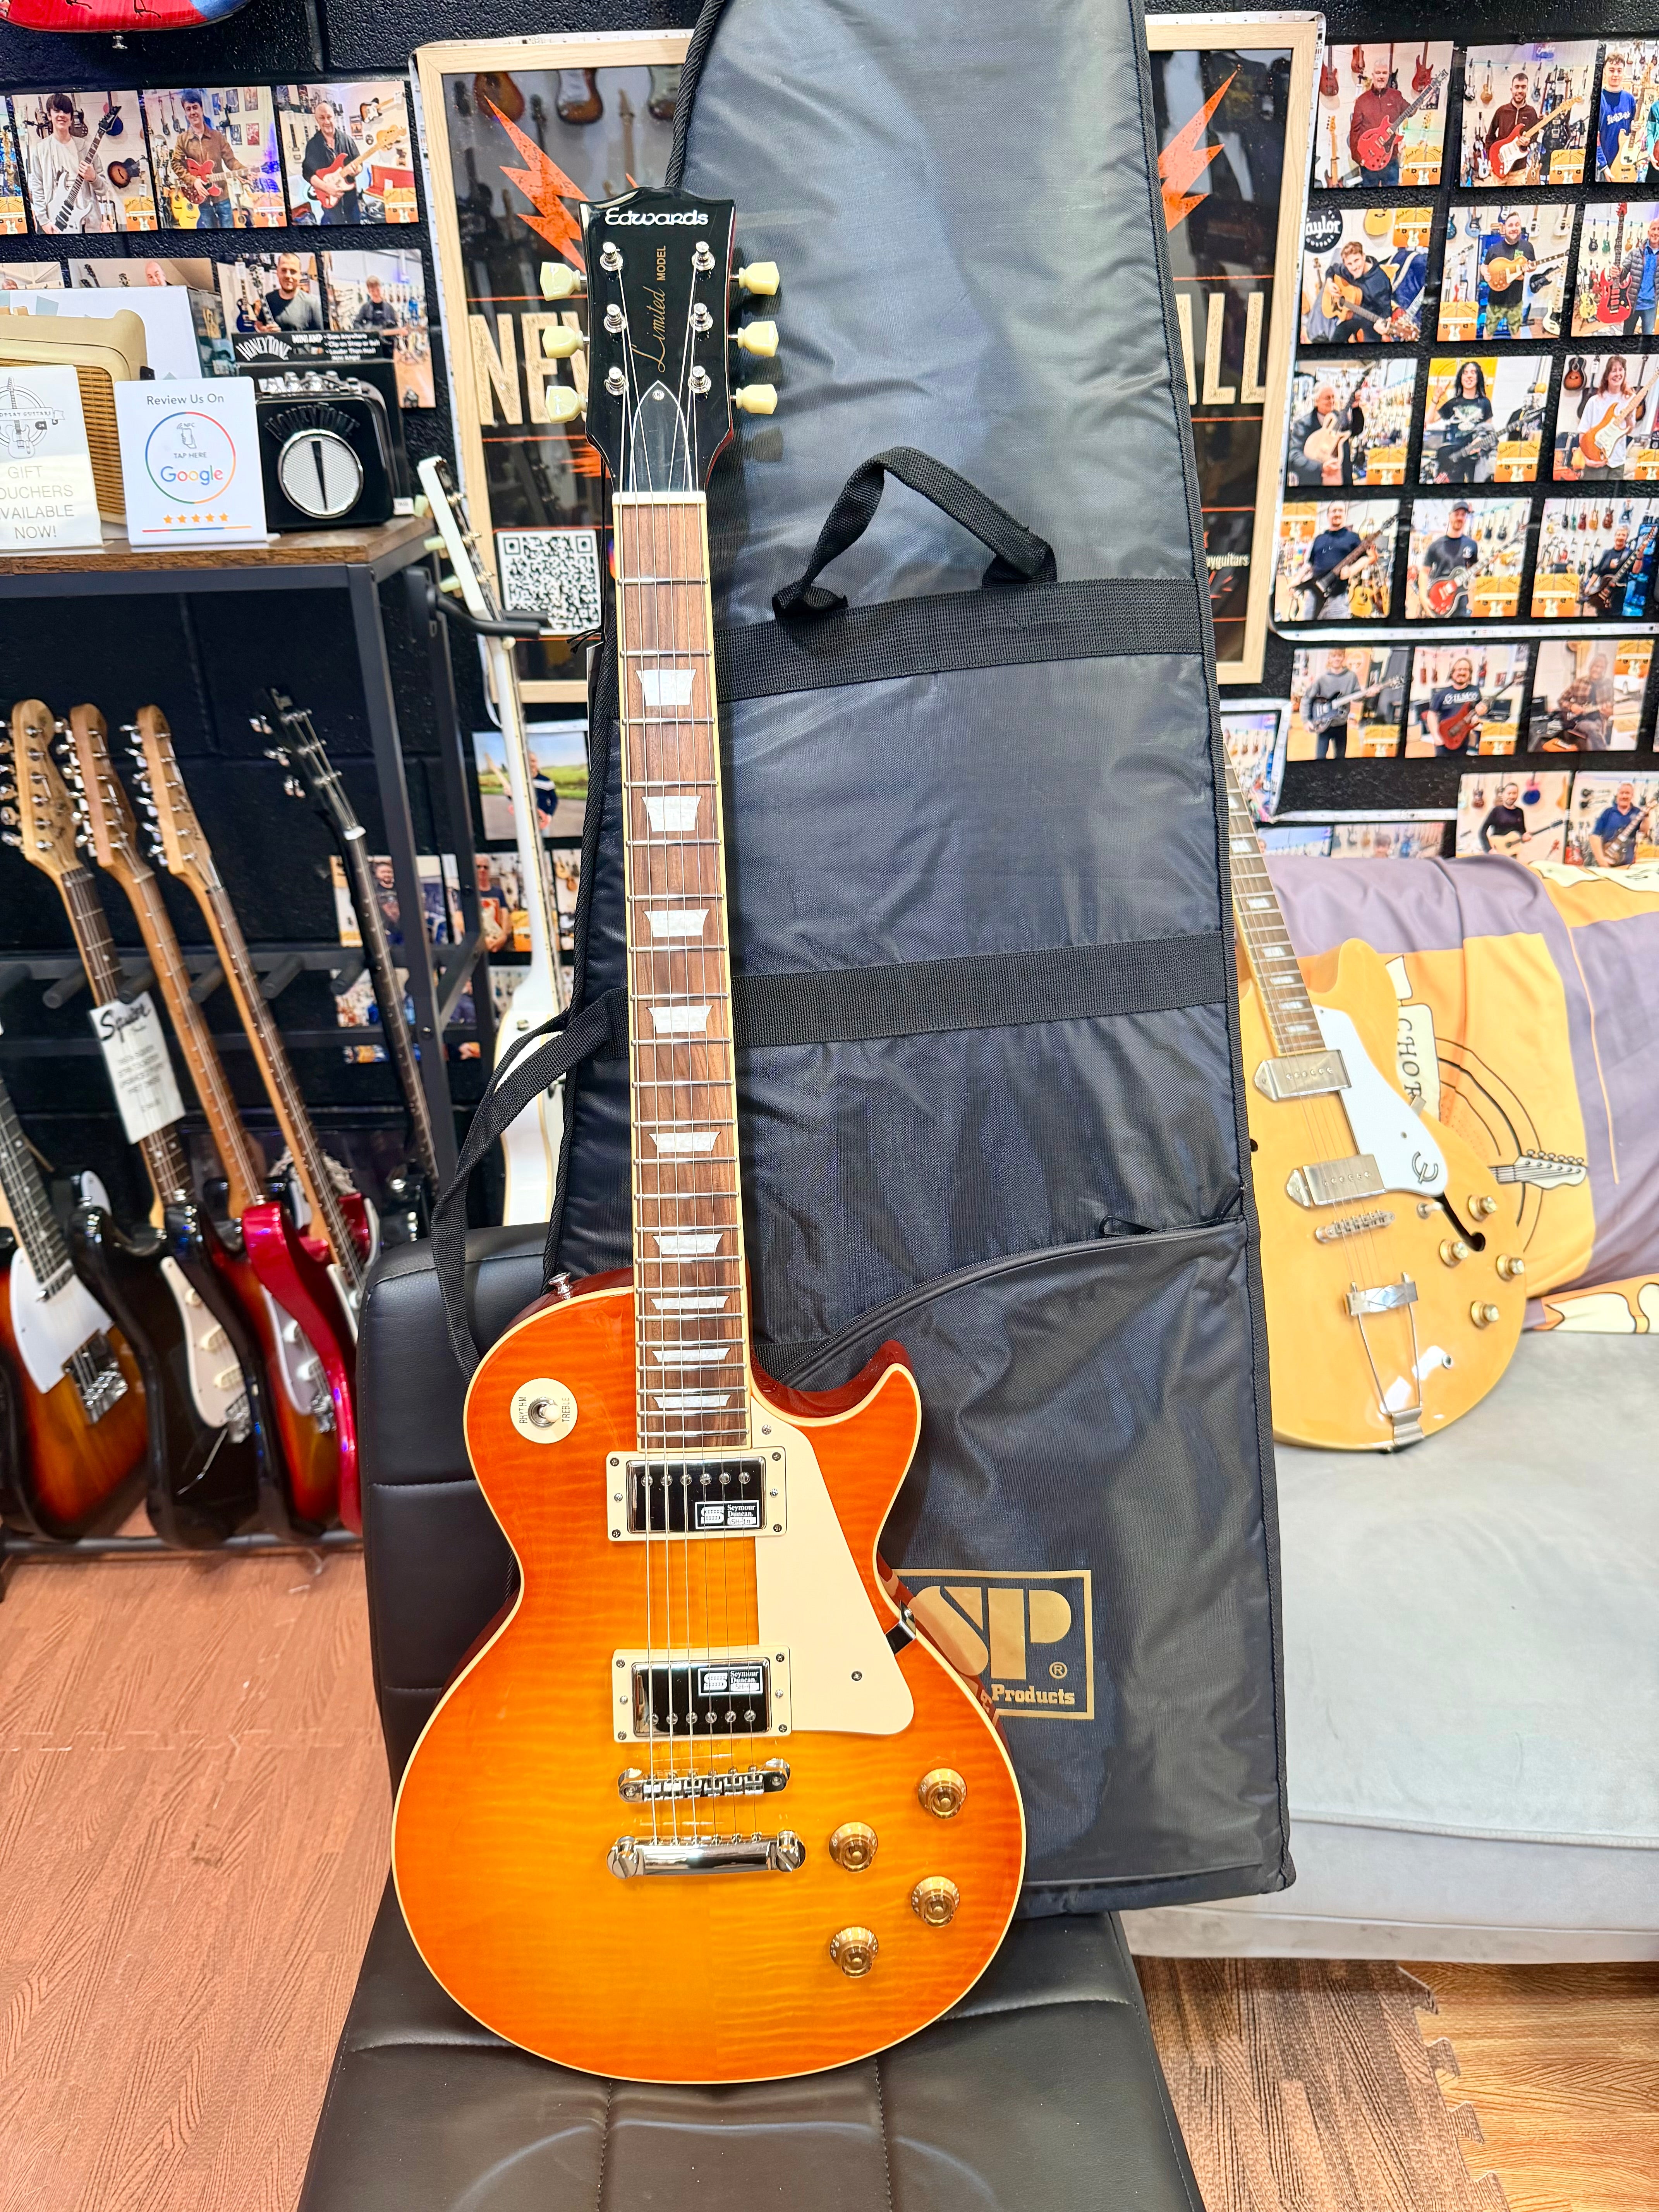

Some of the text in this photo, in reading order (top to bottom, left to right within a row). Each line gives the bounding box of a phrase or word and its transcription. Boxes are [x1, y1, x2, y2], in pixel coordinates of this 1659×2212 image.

[605, 207, 708, 225] Edwards
[1305, 215, 1341, 239] aylor
[630, 245, 666, 373] Limited MODEL
[236, 335, 292, 361] HONEYTONE
[147, 393, 224, 405] Review Us On
[8, 465, 42, 479] GIFT
[161, 465, 223, 485] Google
[0, 484, 74, 500] OUCHERS
[0, 505, 75, 519] VAILABLE
[15, 526, 56, 539] NOW!
[1206, 551, 1250, 570] ayguitars
[519, 1396, 528, 1424] RHYTHM
[562, 1397, 570, 1422] TREBLE
[991, 1684, 1075, 1705] Products
